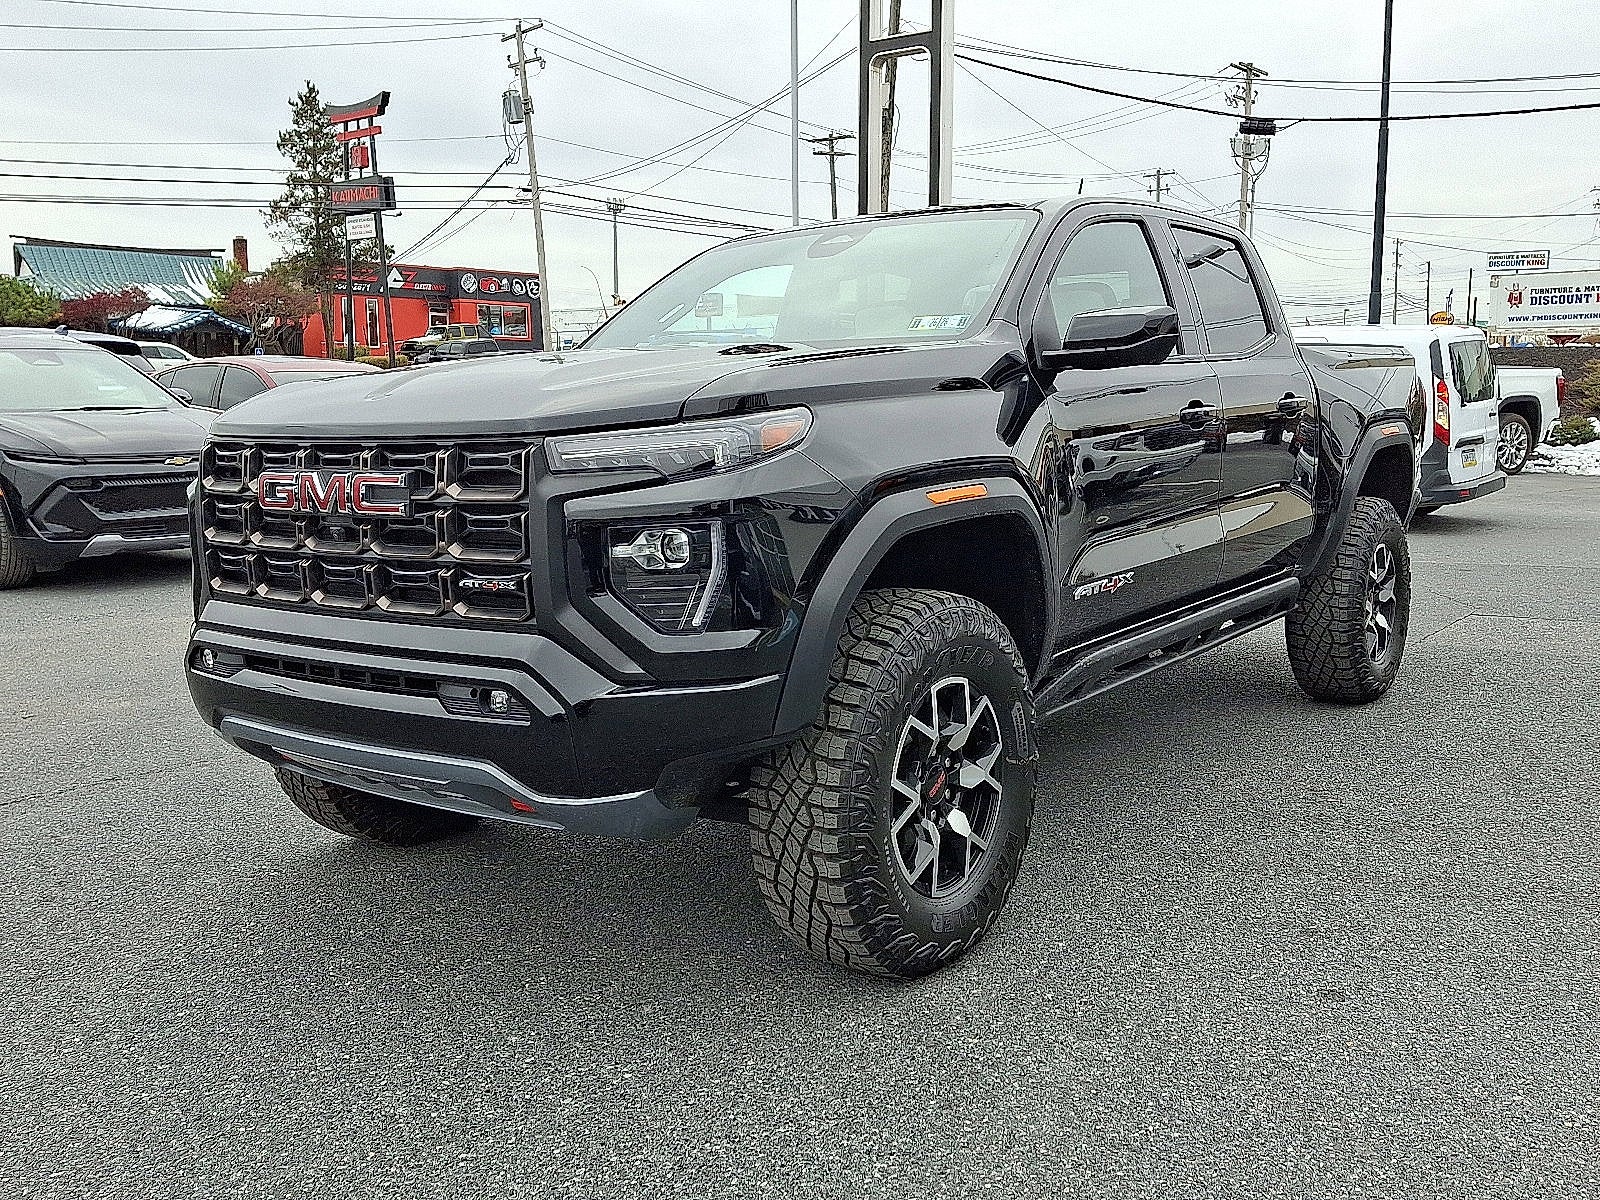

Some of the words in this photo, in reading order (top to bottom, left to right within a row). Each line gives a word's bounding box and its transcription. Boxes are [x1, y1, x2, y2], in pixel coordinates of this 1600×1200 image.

[1530, 286, 1573, 295] FURNITURE
[1530, 294, 1592, 305] DISCOUNT
[1508, 312, 1600, 322] WWW.FMDISCOUNTKIN
[257, 471, 405, 515] GMC
[459, 579, 517, 592] AT4X
[1073, 571, 1134, 600] AT4X
